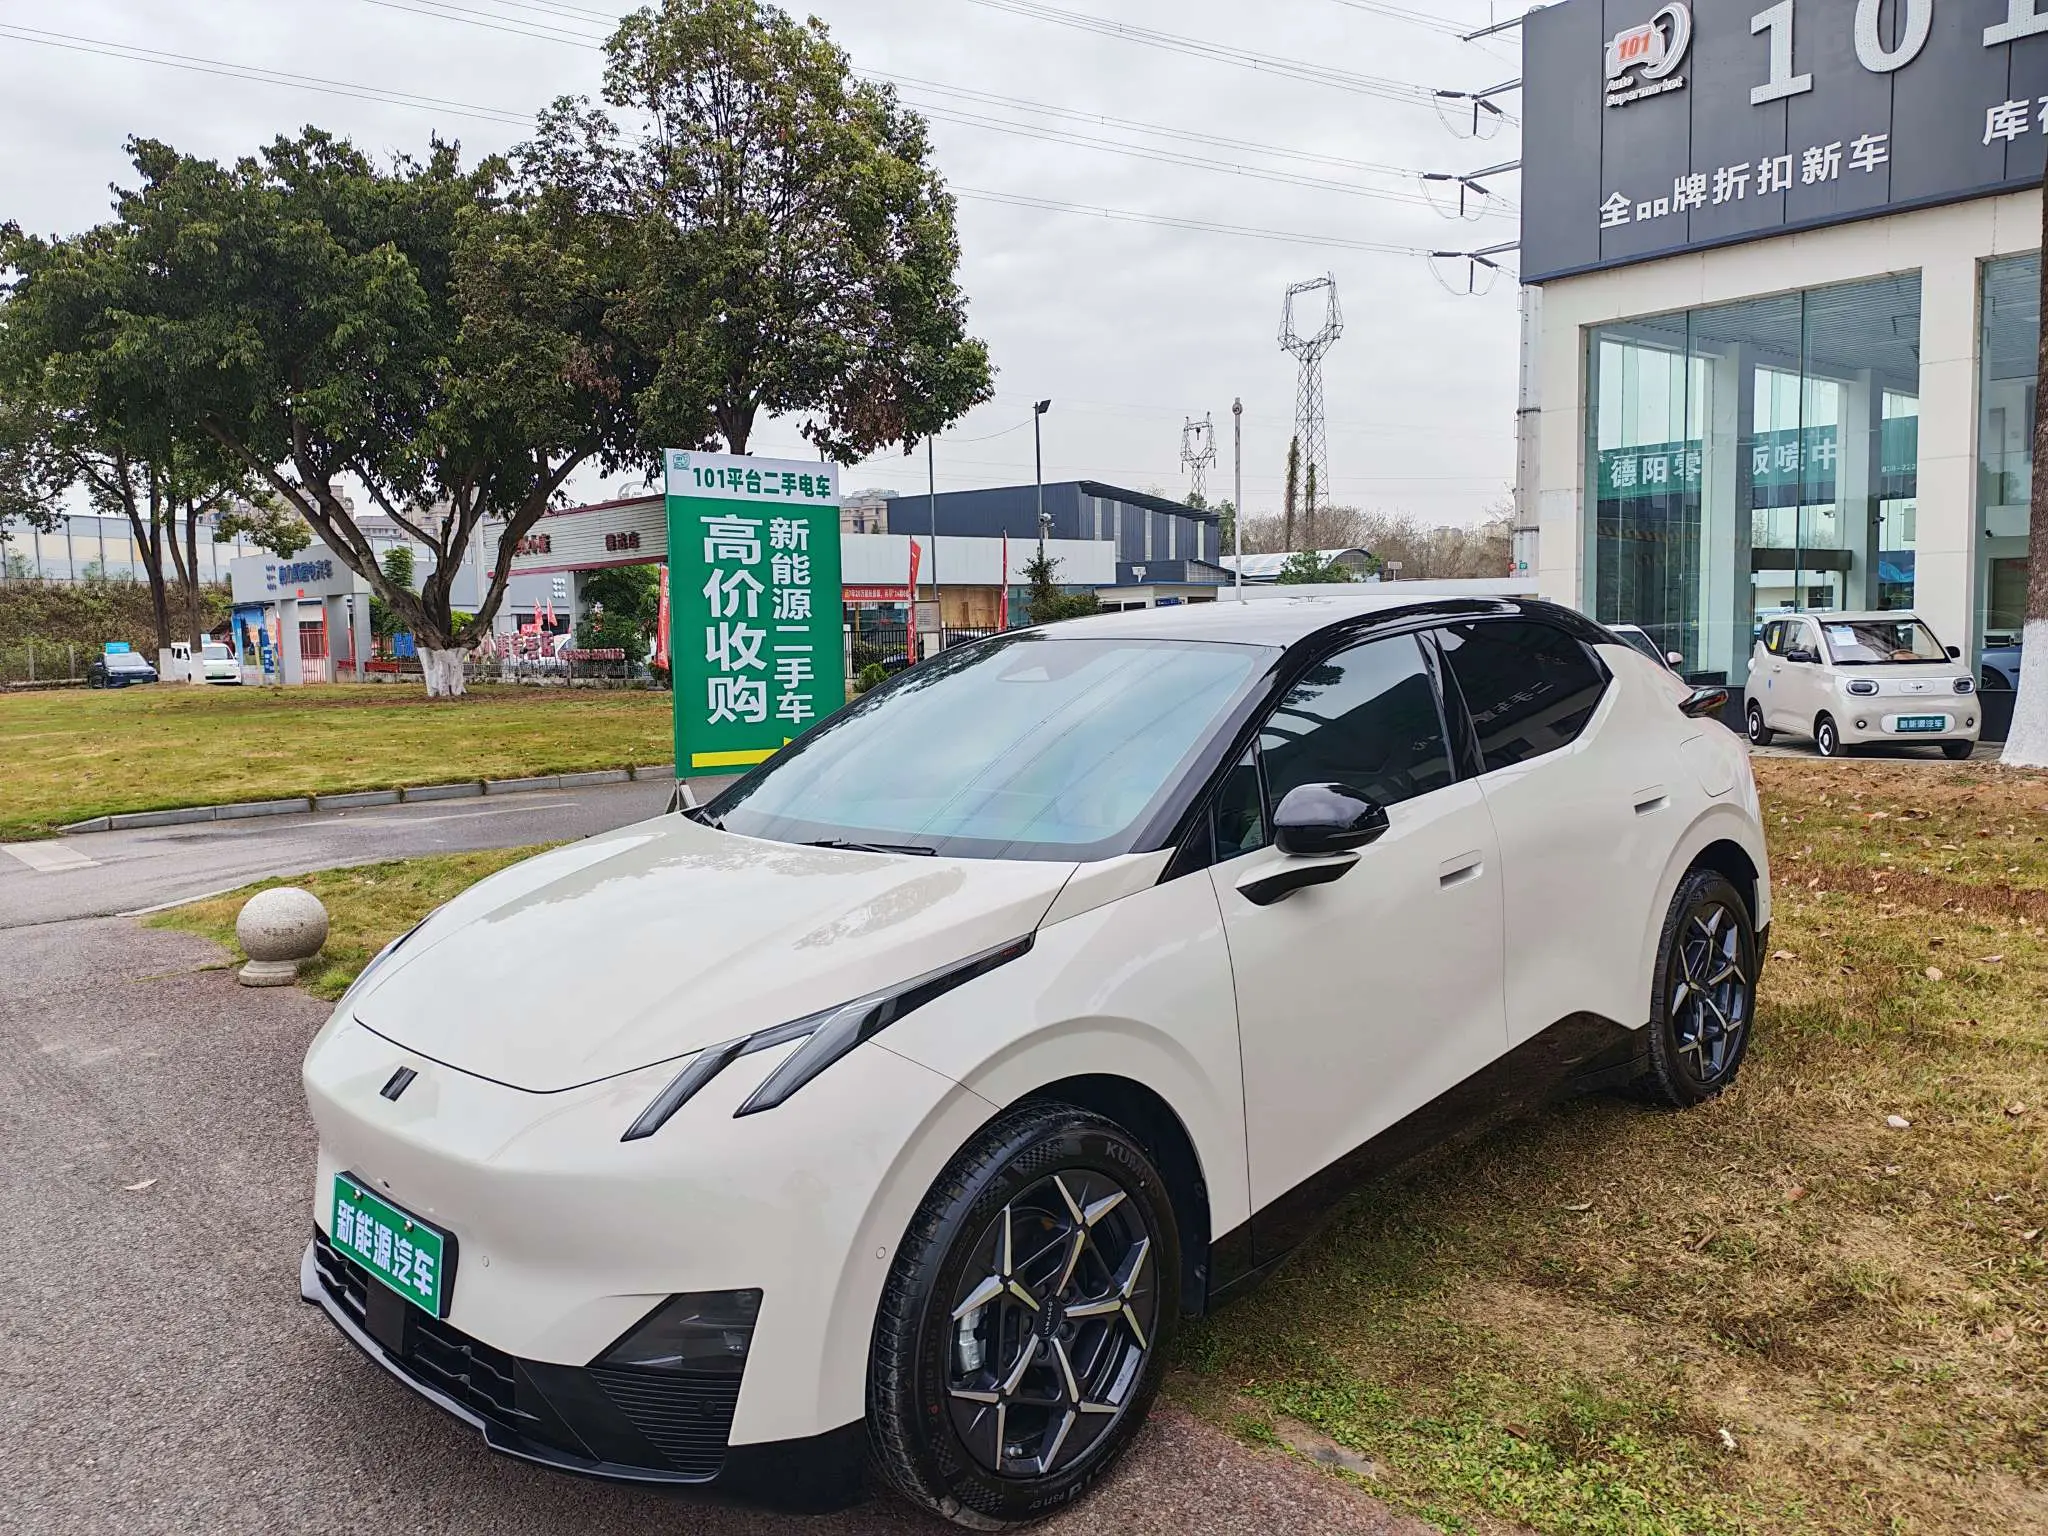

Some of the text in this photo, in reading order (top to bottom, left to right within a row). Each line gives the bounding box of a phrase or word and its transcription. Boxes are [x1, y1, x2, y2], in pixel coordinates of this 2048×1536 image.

[1618, 31, 1650, 59] 101
[1605, 76, 1634, 93] Auto
[1605, 76, 1684, 106] Supermarket
[1599, 132, 1890, 229] 全品牌折扣新车
[693, 467, 831, 498] 101平台二手电车
[700, 513, 768, 725] 高价收购
[769, 516, 815, 724] 新能源二手车
[335, 1198, 435, 1297] 新能源汽车
